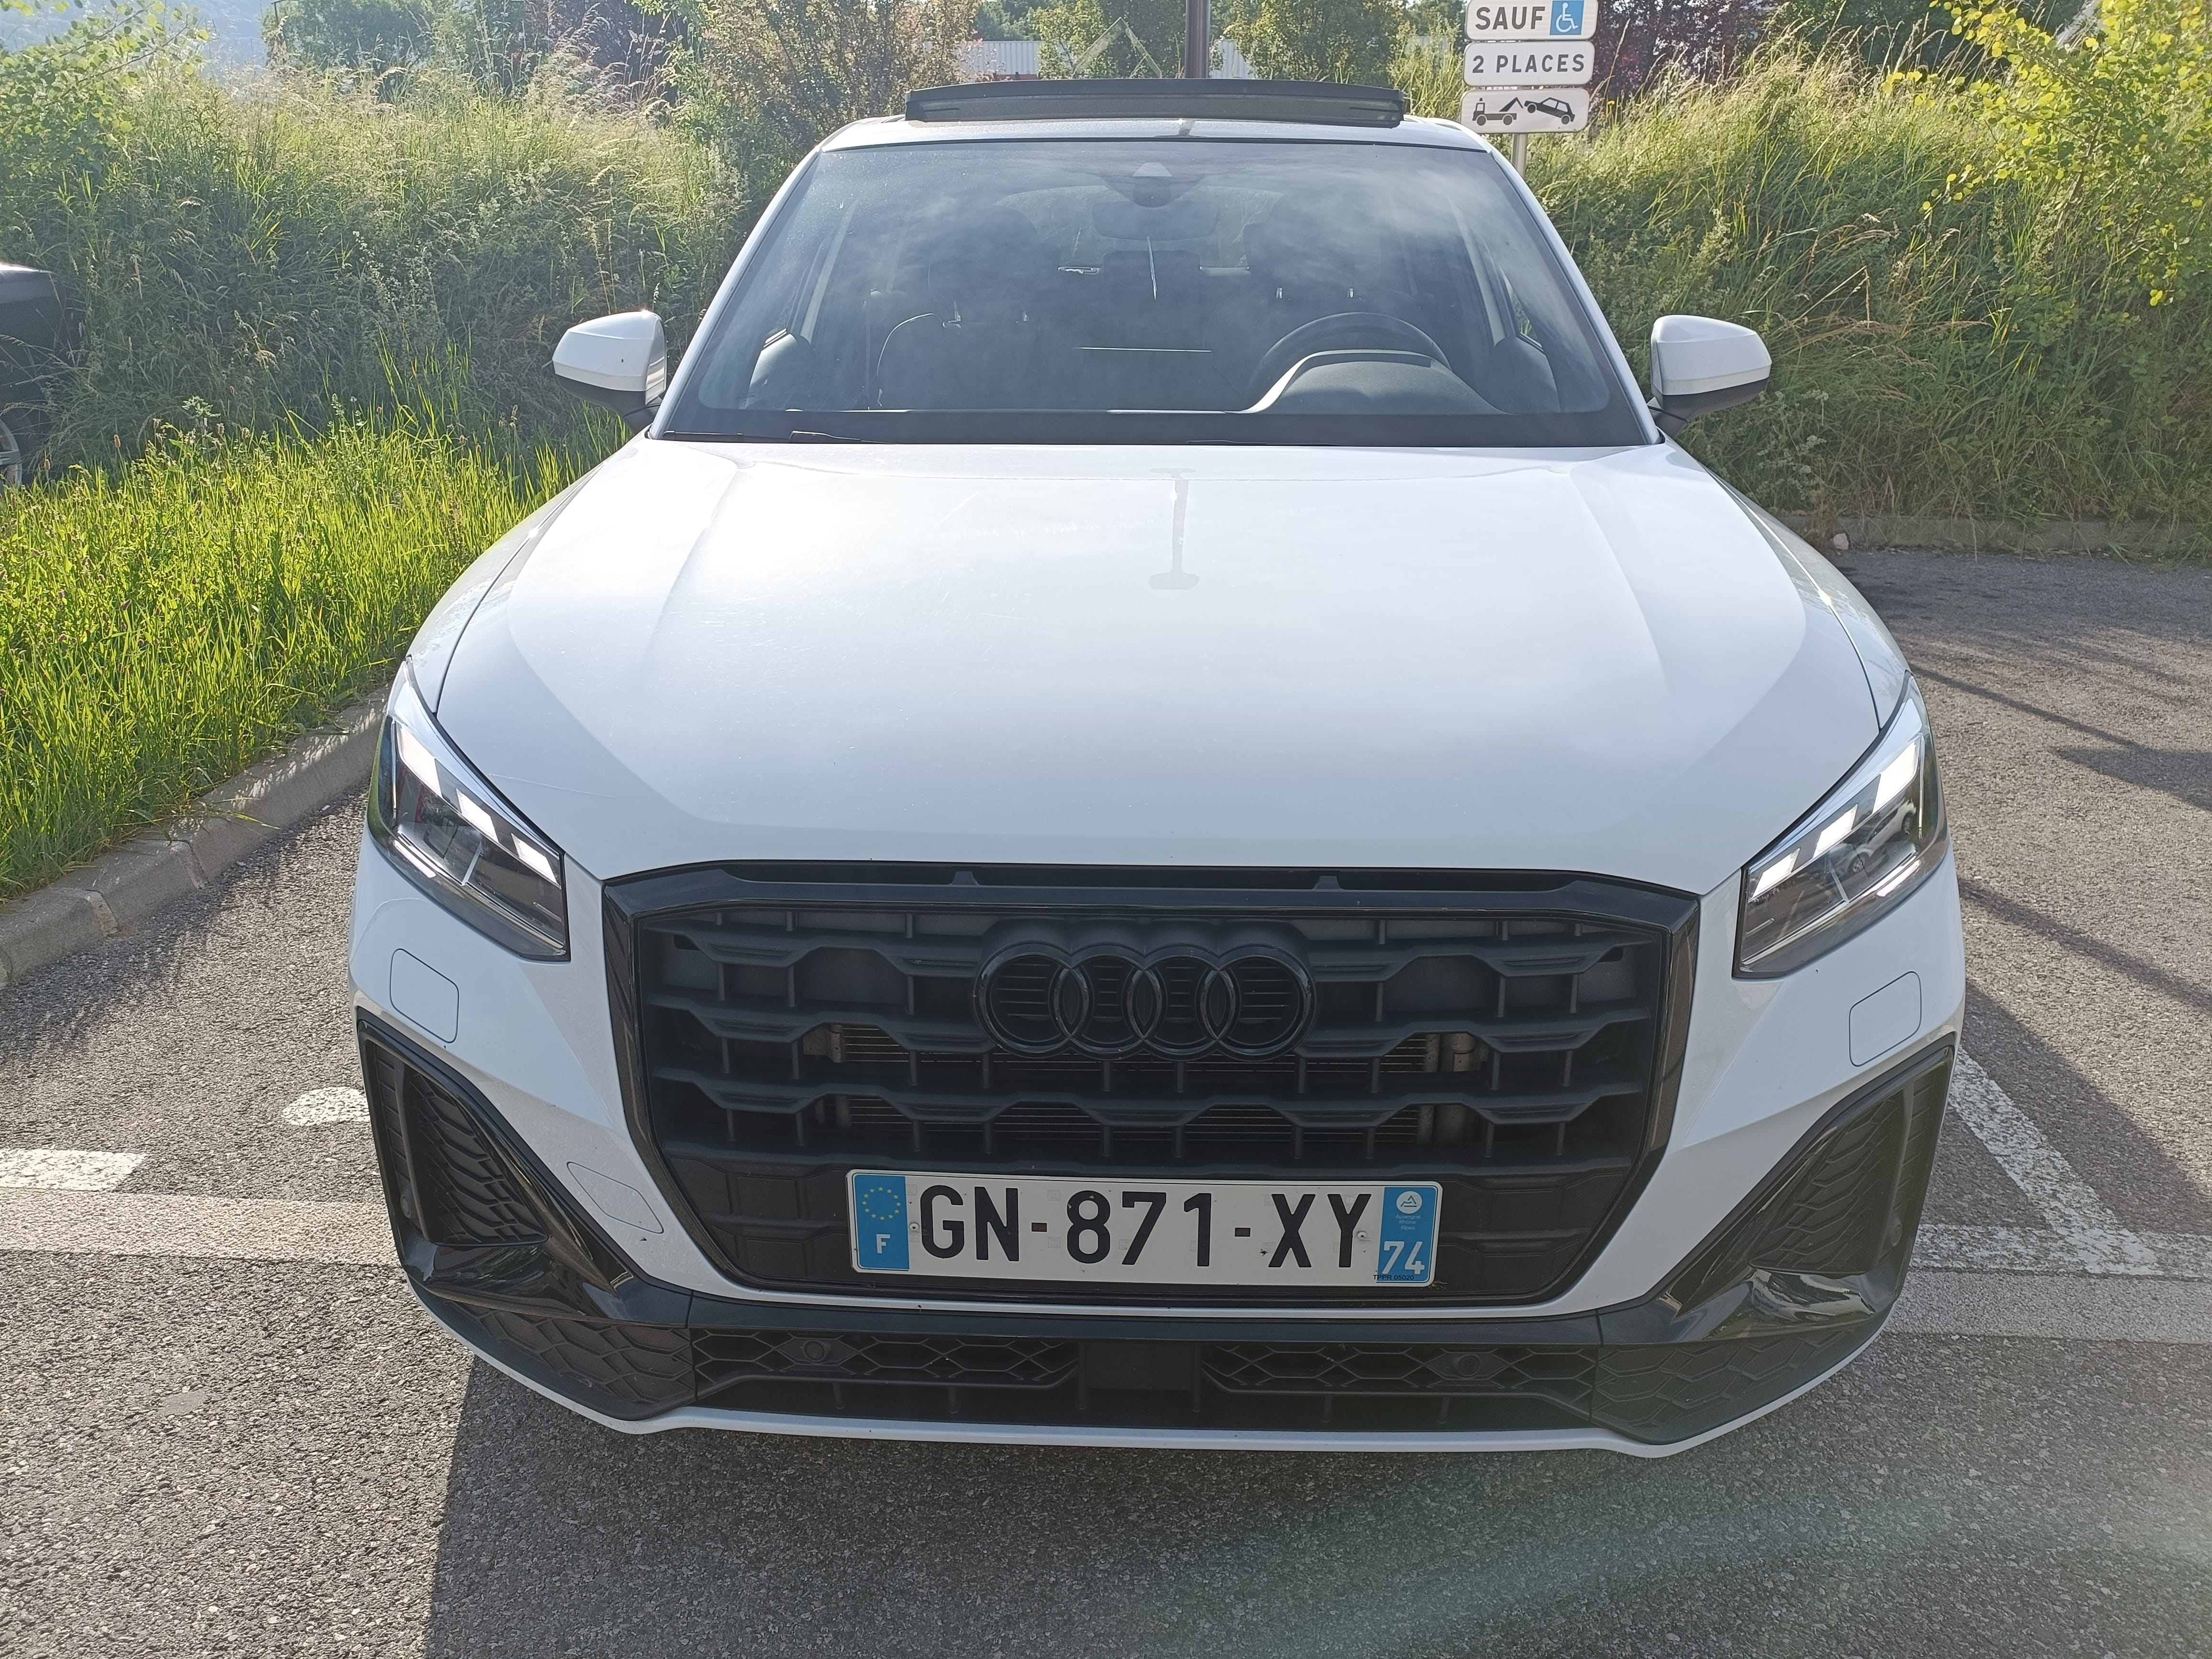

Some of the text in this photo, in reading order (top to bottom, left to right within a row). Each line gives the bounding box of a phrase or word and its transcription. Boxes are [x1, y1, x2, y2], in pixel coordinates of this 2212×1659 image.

[1475, 6, 1545, 30] SAUF
[1472, 54, 1584, 73] 2 PLACES
[920, 1184, 1371, 1268] GN-871-XY
[876, 1234, 891, 1254] F
[1382, 1241, 1425, 1275] 74
